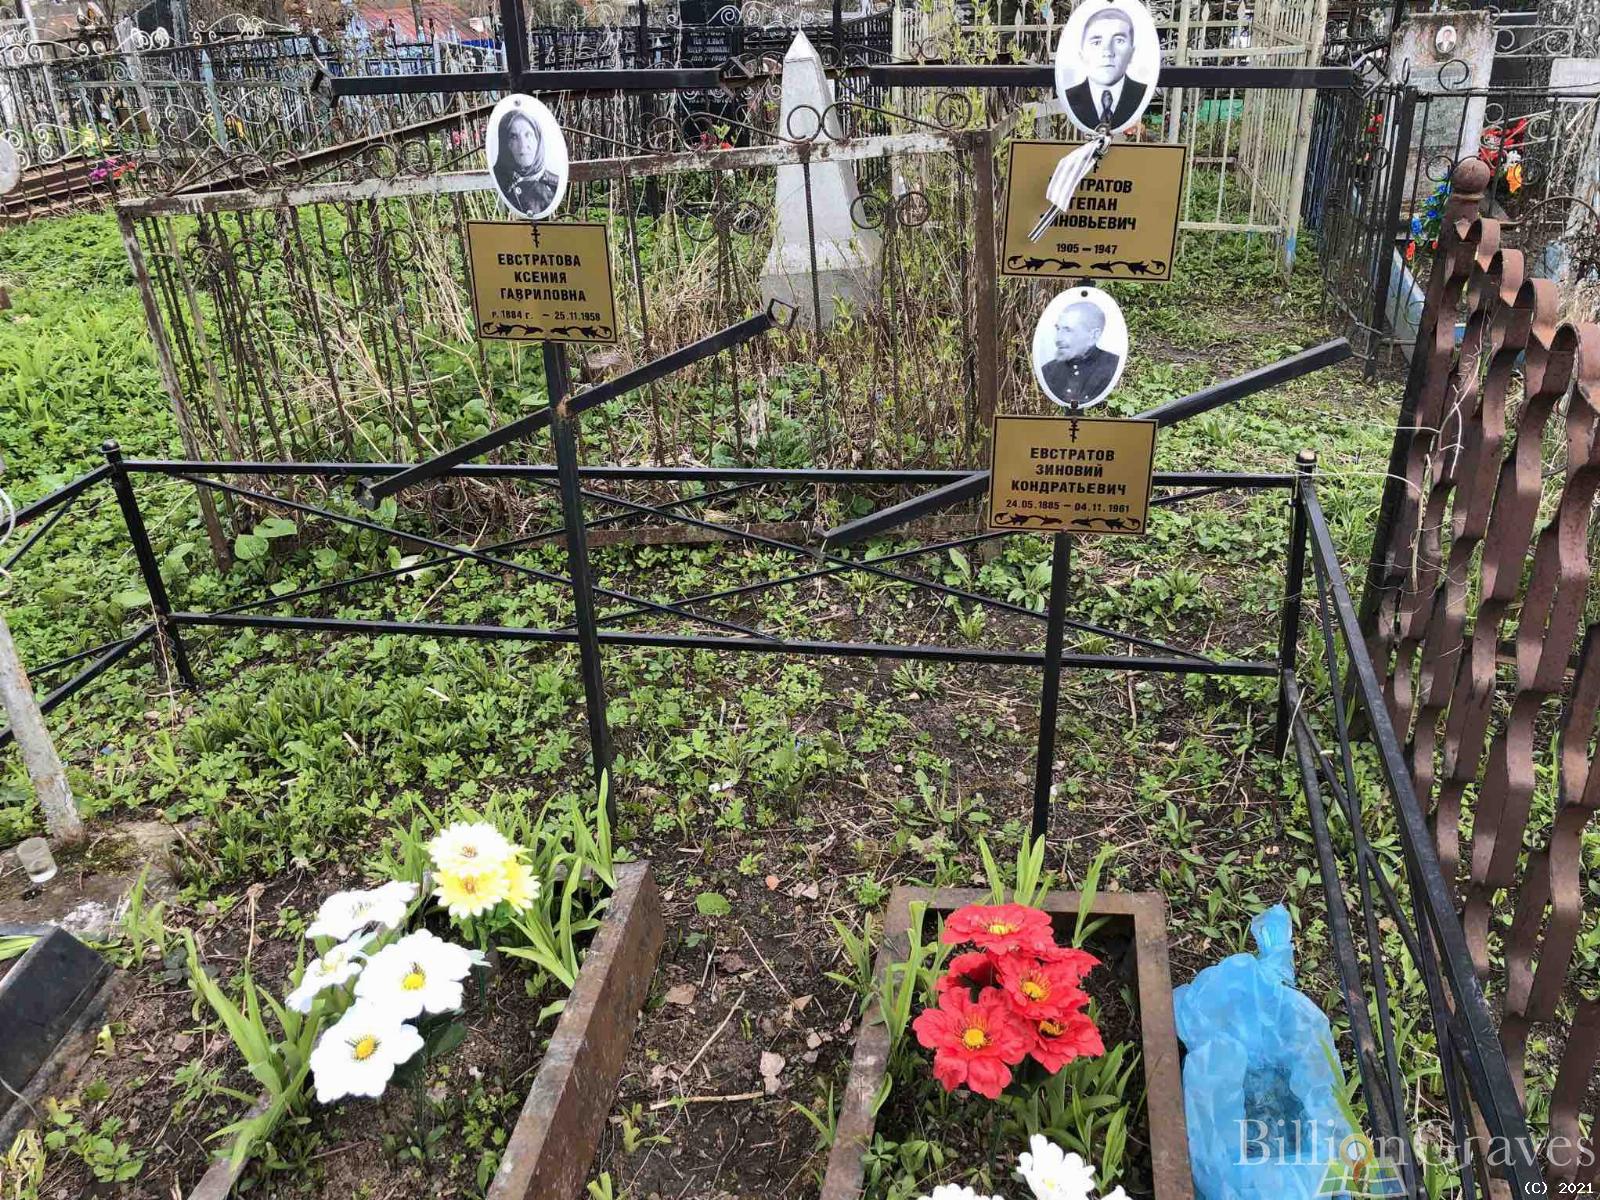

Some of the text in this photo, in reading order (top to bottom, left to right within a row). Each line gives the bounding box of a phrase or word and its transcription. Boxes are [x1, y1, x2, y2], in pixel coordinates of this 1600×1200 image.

[1049, 177, 1133, 194] ТРАТОВ
[1068, 197, 1118, 211] ТЕПАН
[1040, 214, 1137, 230] ИНОВЬЕВИЧ
[1056, 243, 1079, 253] 1905
[1094, 244, 1118, 255] 1947
[497, 253, 581, 267] ЕВСТРАТОВА
[514, 271, 567, 284] КСЕНИЯ
[500, 288, 586, 302] ГАВРИЛОВНА
[554, 310, 601, 322] 25.11.1958
[1030, 447, 1115, 461] ЕВСТРАТОВ
[1035, 463, 1103, 478] ЗИНОВИЙ
[1011, 480, 1126, 496] КОНДРАТЬЕВИЧ
[1006, 499, 1060, 510] 24.05.1885
